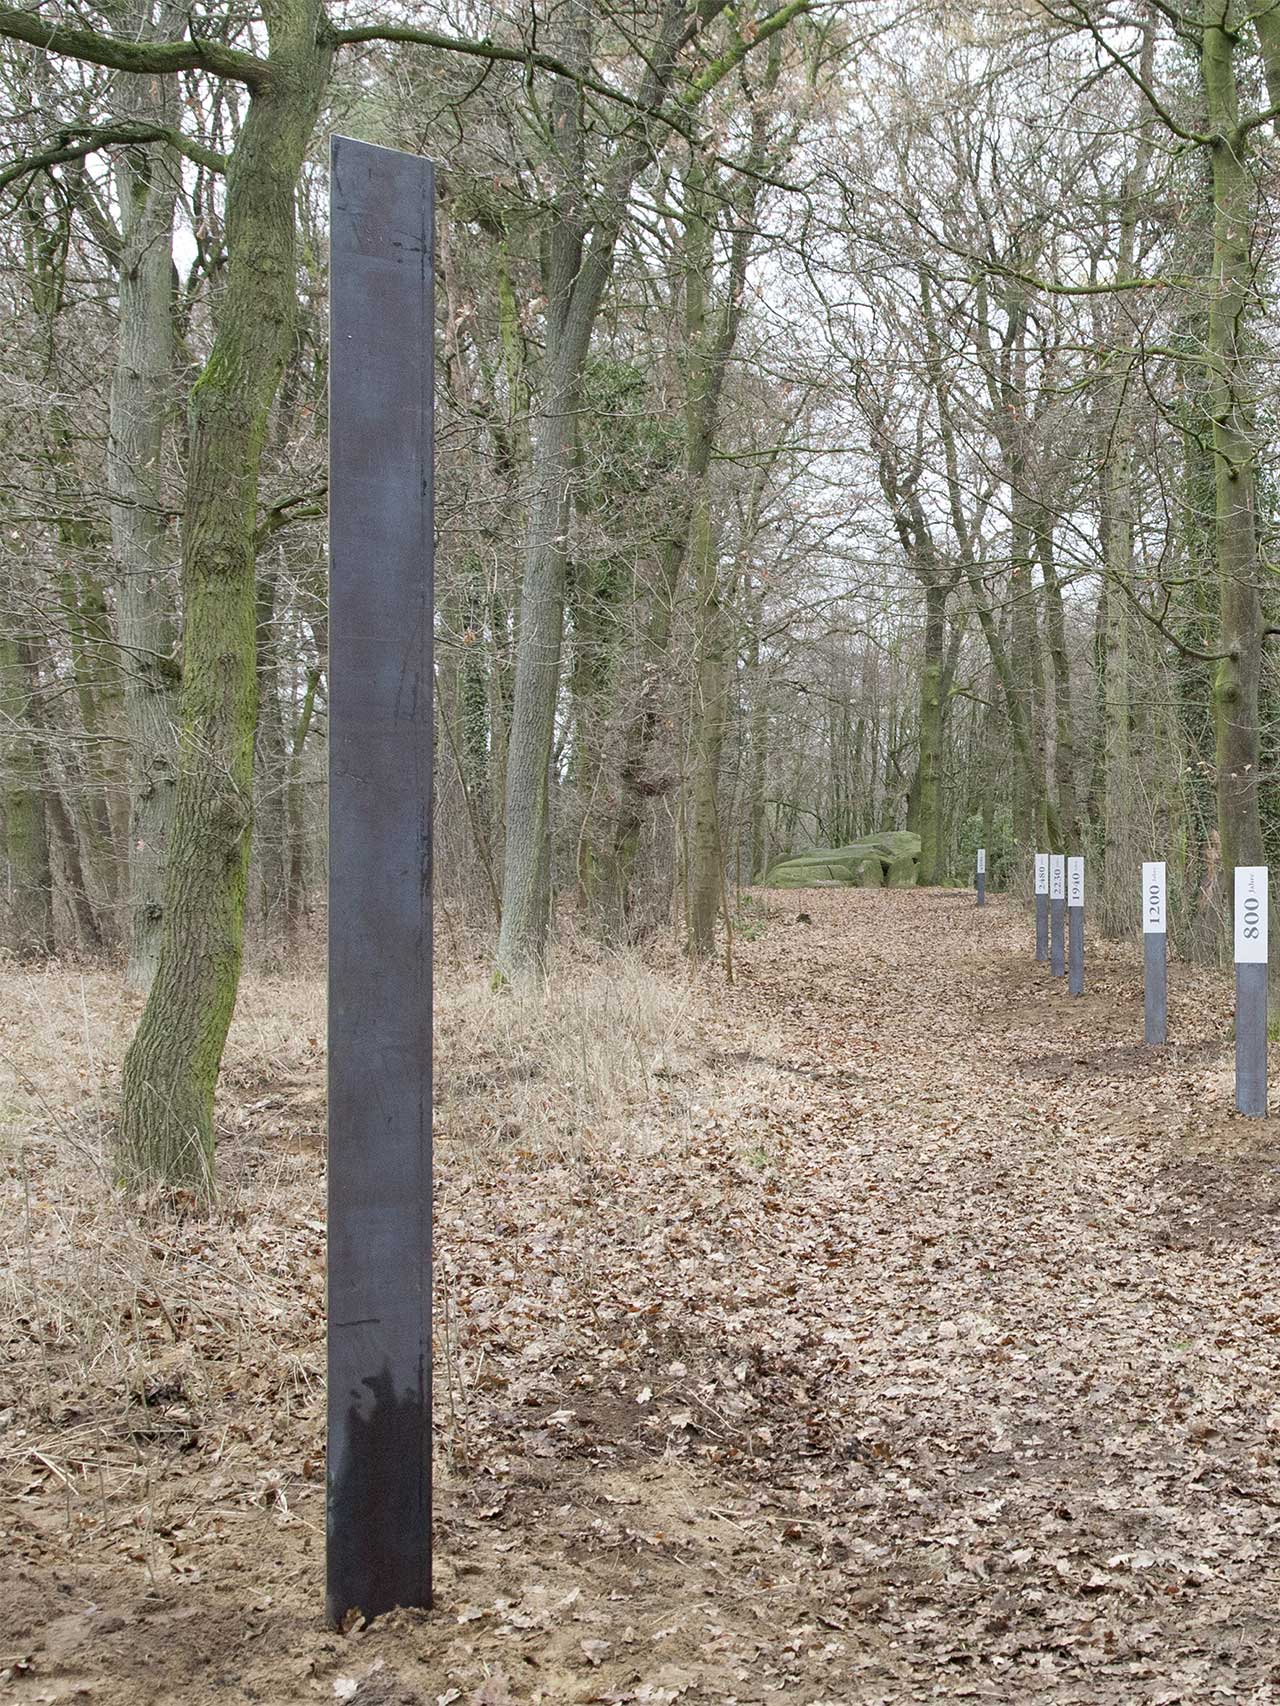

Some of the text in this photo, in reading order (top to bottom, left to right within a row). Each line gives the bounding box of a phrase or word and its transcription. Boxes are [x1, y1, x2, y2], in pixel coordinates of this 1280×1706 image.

[1053, 868, 1062, 895] 2230
[1149, 885, 1160, 924] 1200
[1243, 873, 1260, 940] 800 Jahre
